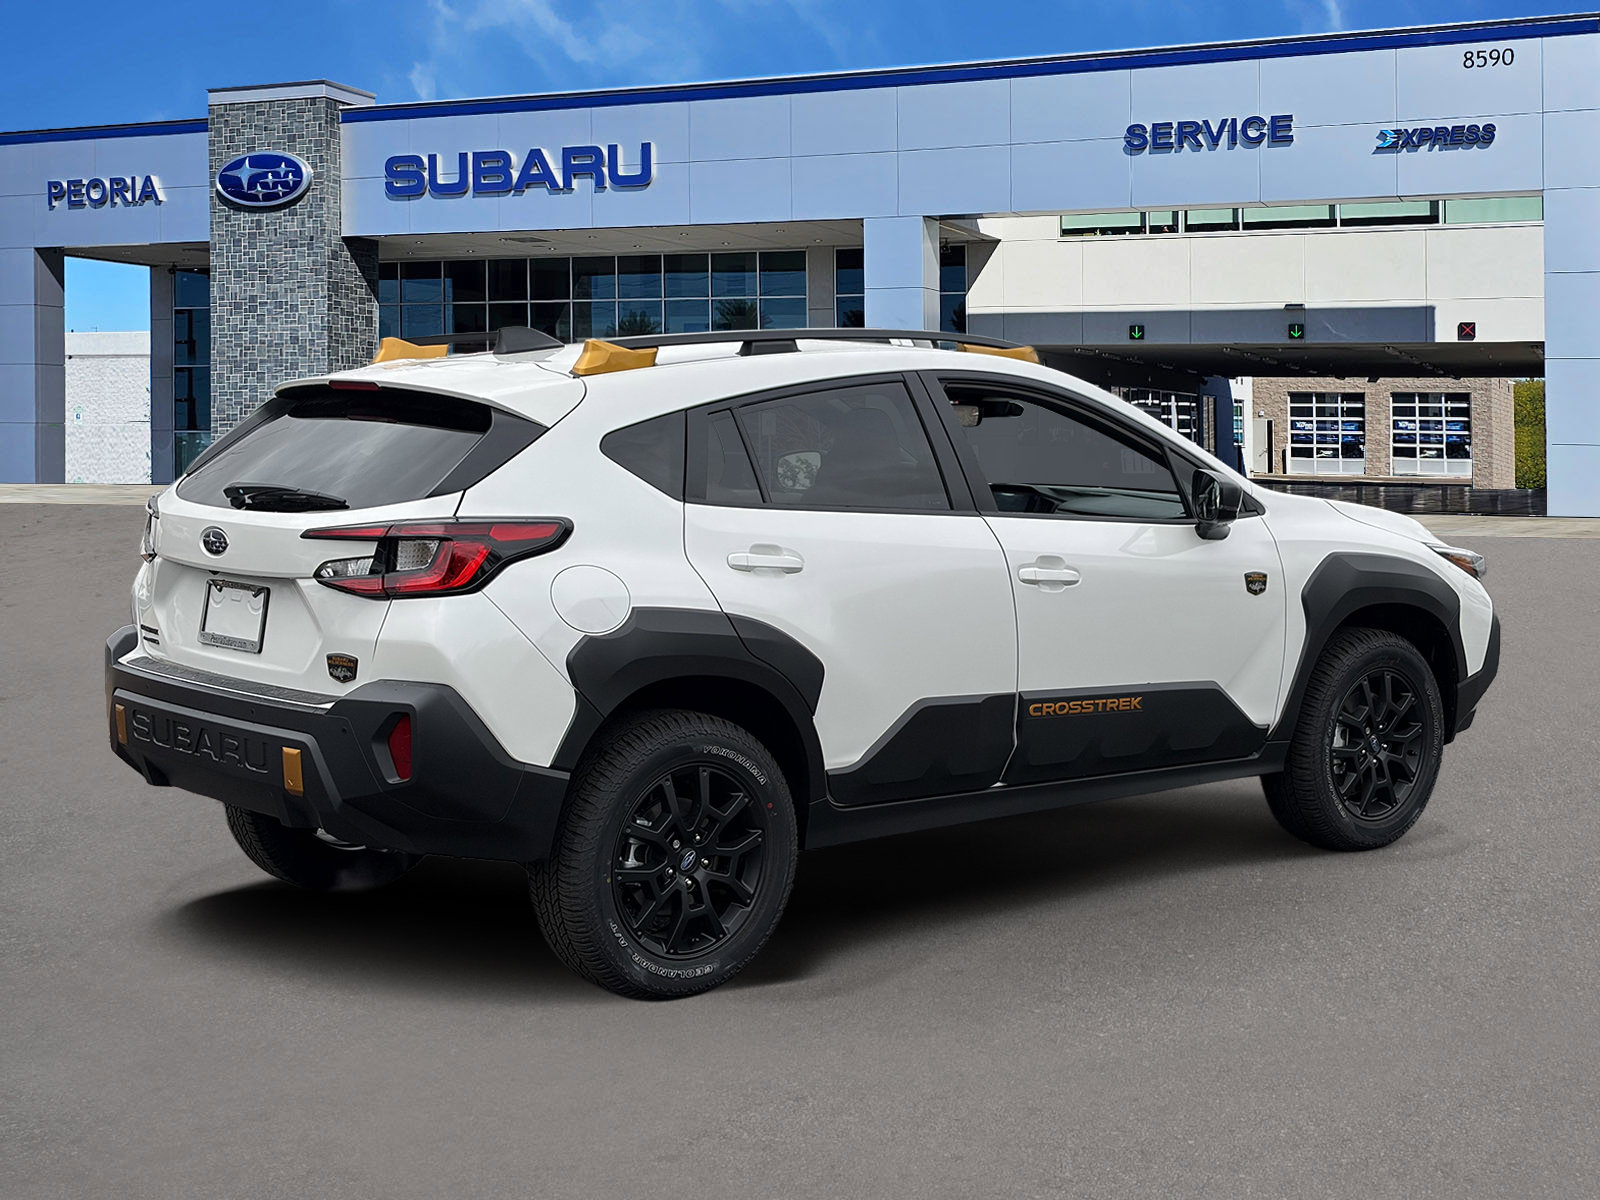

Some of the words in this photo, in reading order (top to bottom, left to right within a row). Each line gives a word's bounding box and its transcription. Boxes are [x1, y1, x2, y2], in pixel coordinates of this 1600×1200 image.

[1463, 48, 1515, 69] 8590
[1124, 115, 1294, 150] SERVICE
[385, 142, 653, 197] SUBARU
[47, 174, 160, 208] PEORIA
[1028, 696, 1143, 718] CROSSTREK
[131, 708, 269, 773] SUBARU
[703, 745, 767, 785] YOKOHAMA
[632, 952, 714, 977] GEOLANDAR
